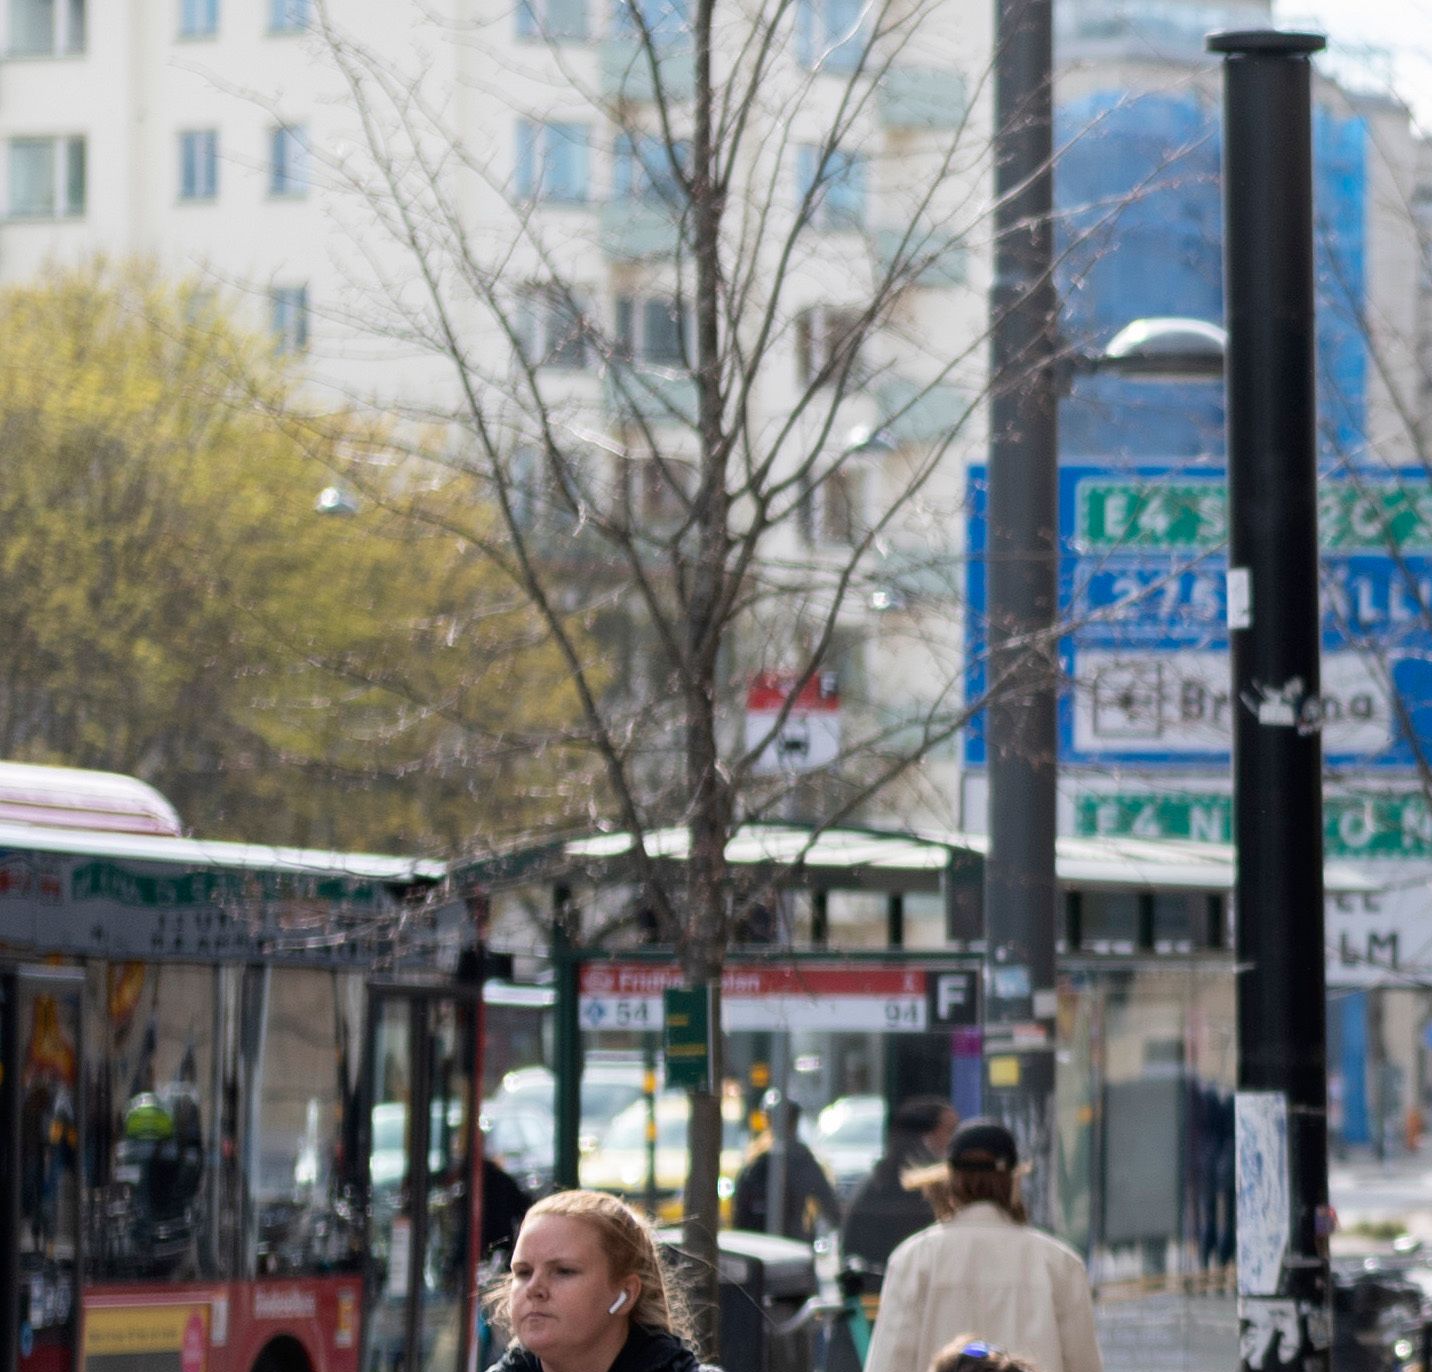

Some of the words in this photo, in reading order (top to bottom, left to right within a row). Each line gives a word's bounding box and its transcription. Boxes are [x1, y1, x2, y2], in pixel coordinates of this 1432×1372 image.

[1104, 495, 1171, 537] E4
[615, 1000, 650, 1027] 54
[884, 1002, 920, 1029] 94
[937, 974, 969, 1021] F
